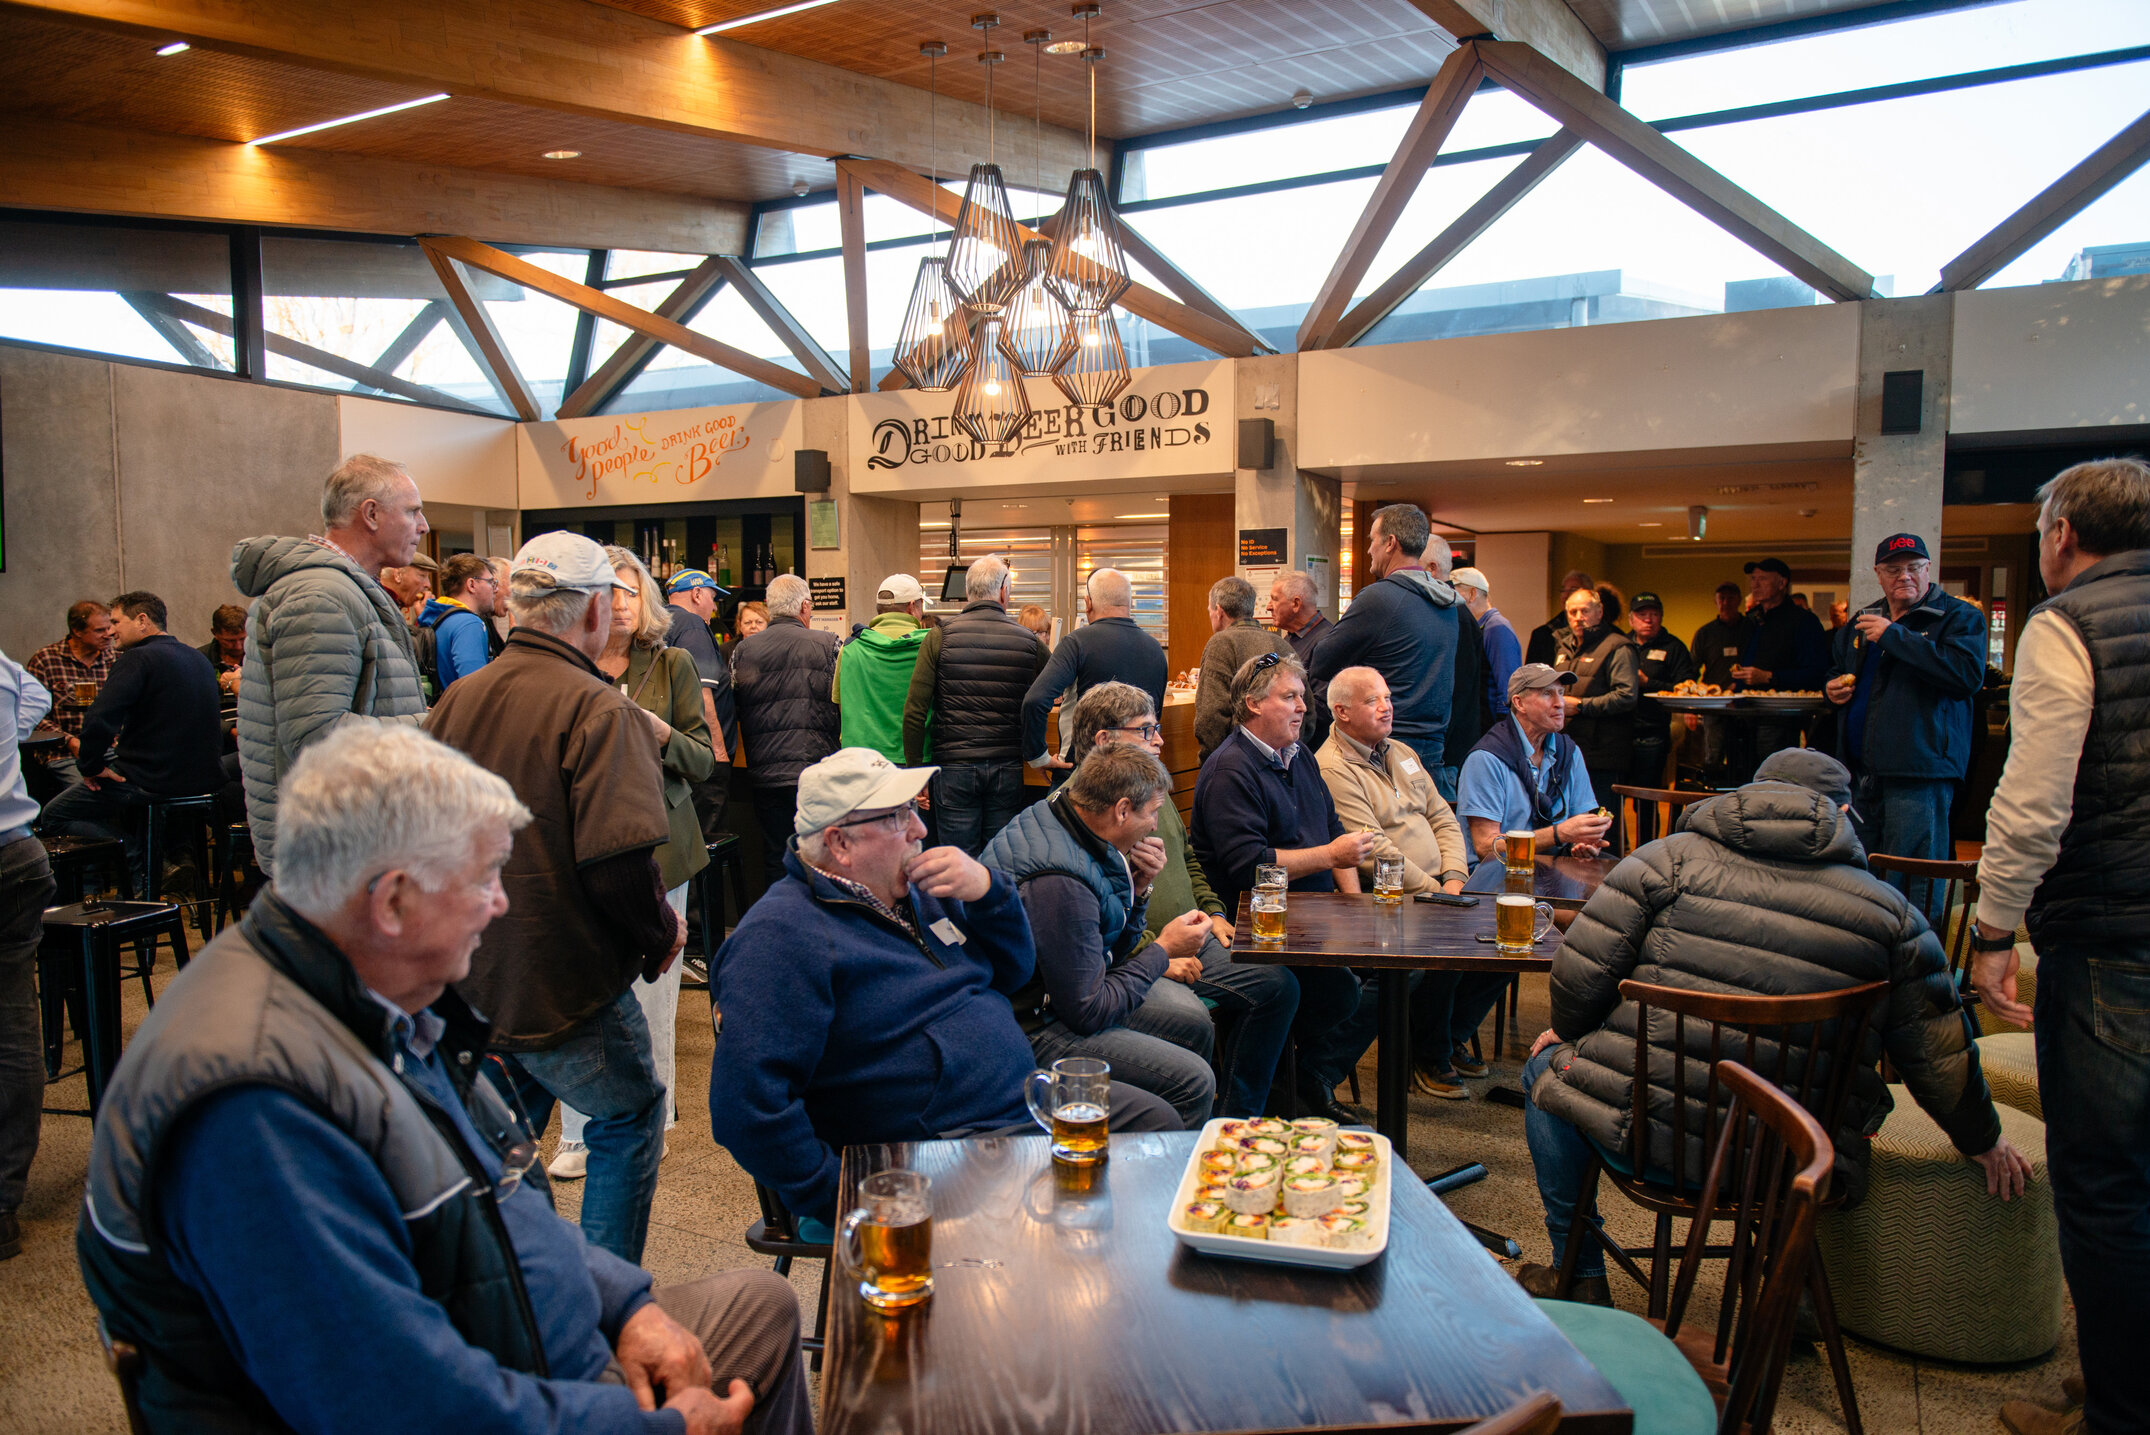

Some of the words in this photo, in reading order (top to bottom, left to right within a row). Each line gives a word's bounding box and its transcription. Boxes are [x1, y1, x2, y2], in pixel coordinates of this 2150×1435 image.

[1092, 389, 1209, 428] GOOD
[661, 424, 702, 450] DRINK
[705, 415, 736, 435] GOOD
[868, 413, 981, 470] DRIN
[1055, 440, 1087, 456] WITH
[1092, 422, 1211, 455] FRIENDS
[910, 439, 986, 464] GOOD
[585, 445, 656, 500] people
[1889, 537, 1916, 551] Lee
